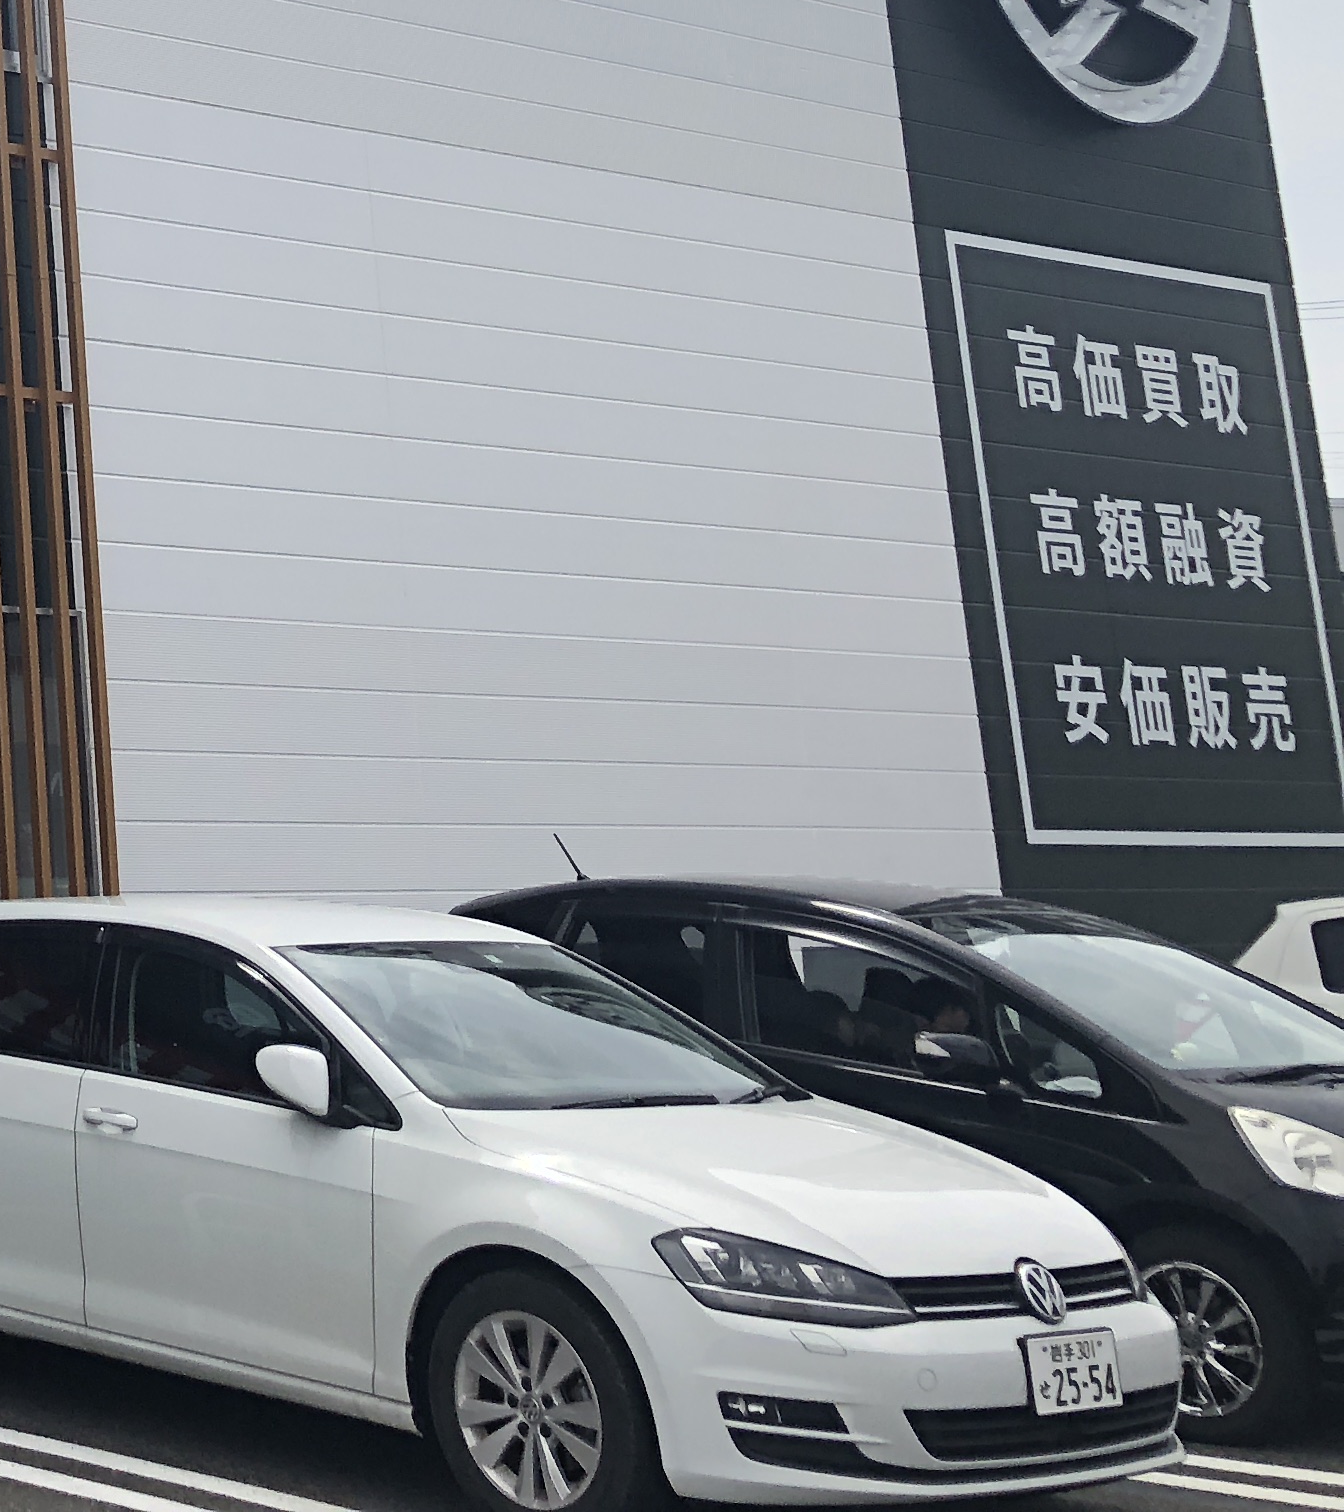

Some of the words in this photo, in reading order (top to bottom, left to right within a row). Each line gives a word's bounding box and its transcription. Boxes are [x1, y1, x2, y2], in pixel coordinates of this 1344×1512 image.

[1007, 324, 1249, 435] 高価買取
[1029, 487, 1272, 593] 高額融資
[1054, 654, 1297, 753] 安価販売
[1051, 1362, 1117, 1407] 25-54
